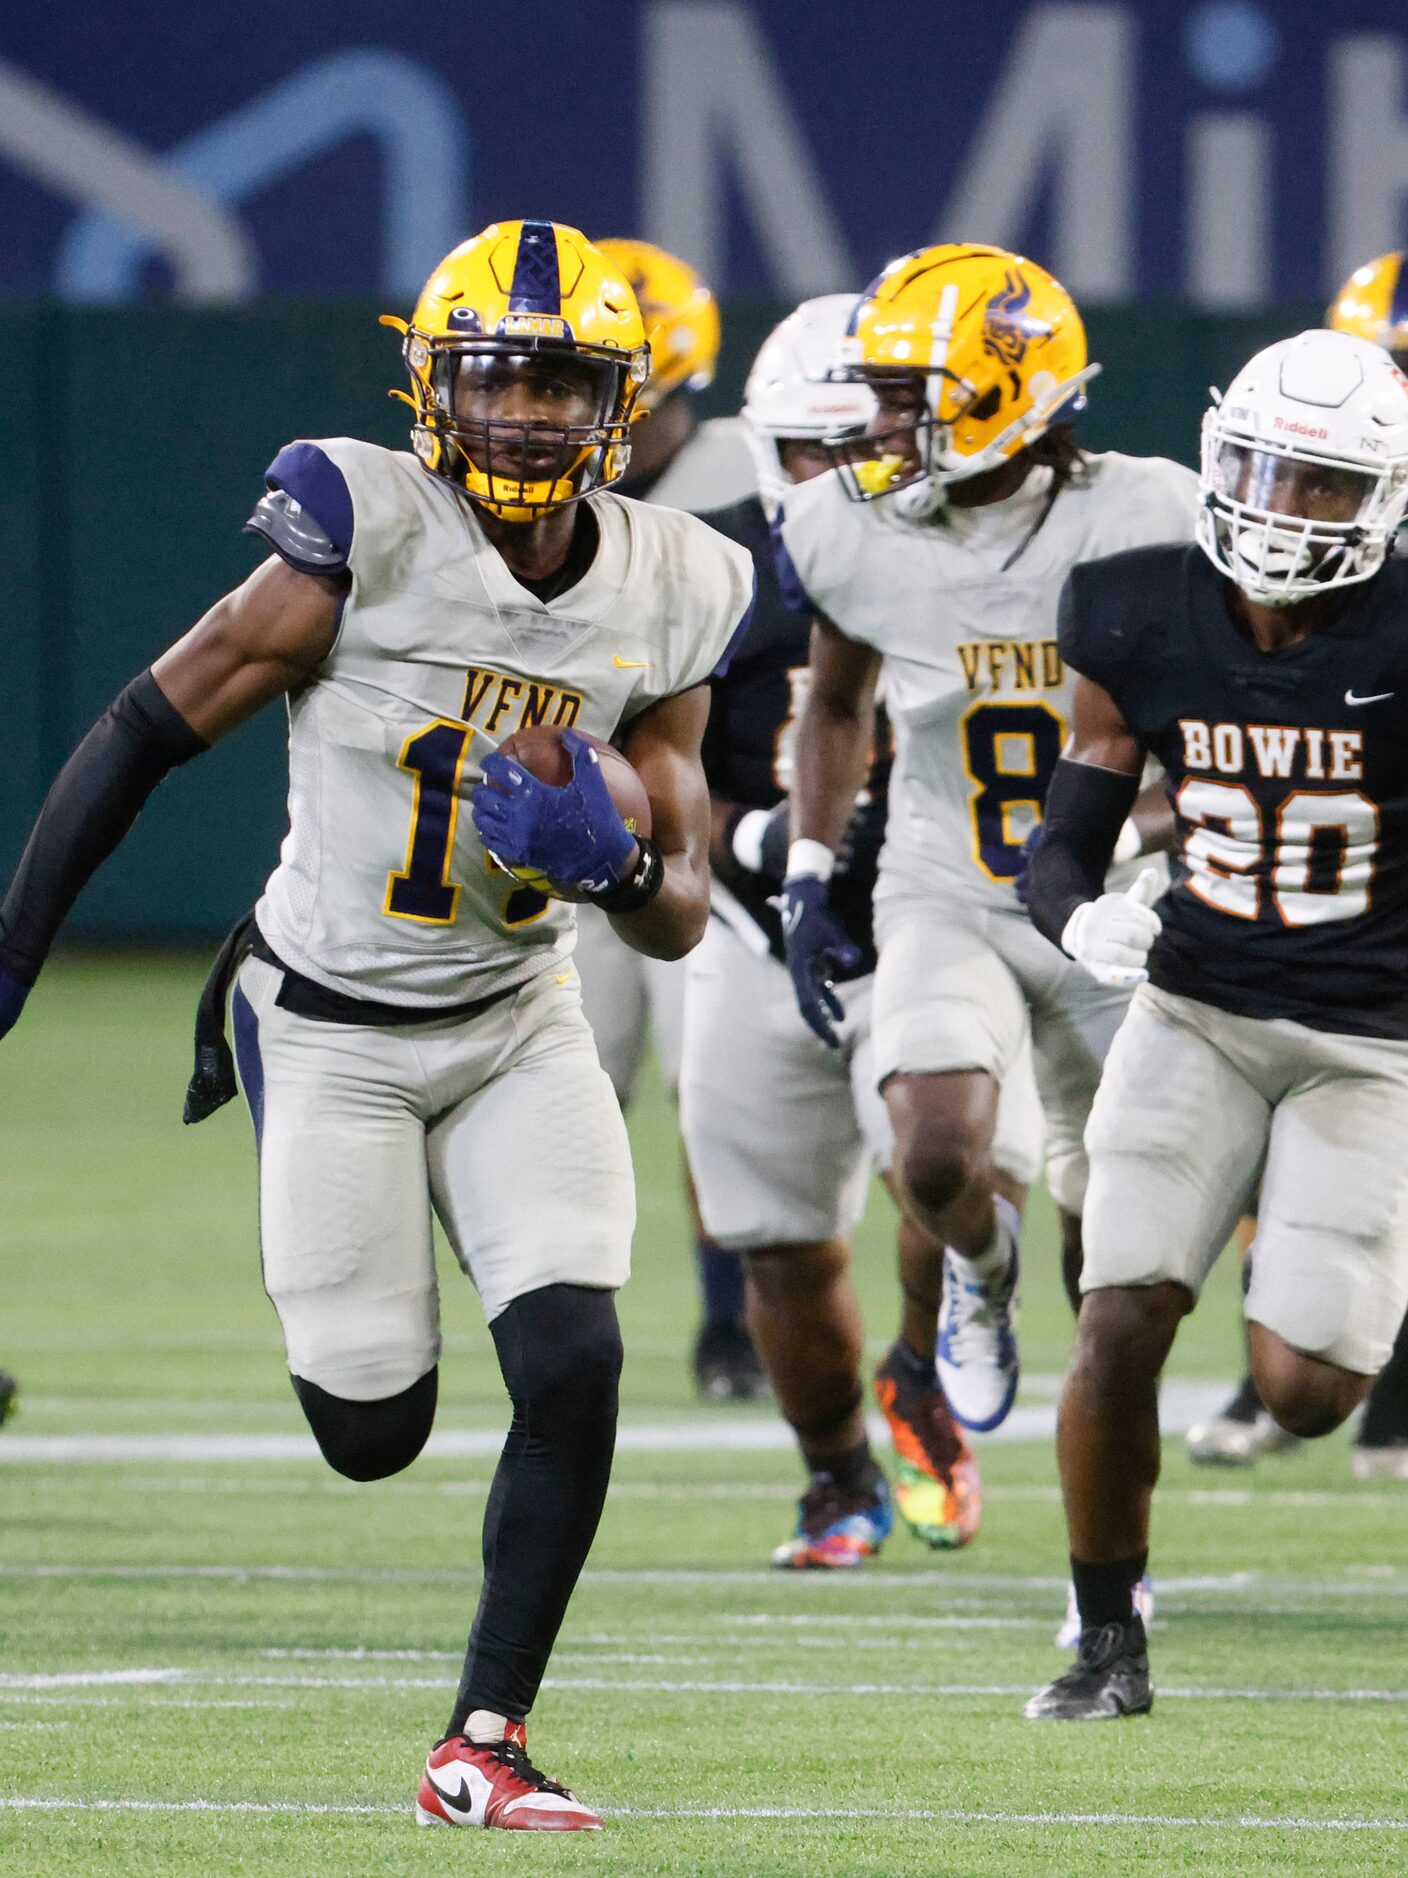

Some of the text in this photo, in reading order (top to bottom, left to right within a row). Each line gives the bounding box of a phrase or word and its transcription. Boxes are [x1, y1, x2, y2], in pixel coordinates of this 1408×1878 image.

[505, 316, 565, 338] LAMAR
[1273, 416, 1329, 441] Riddell
[956, 639, 1064, 693] VFND
[460, 667, 585, 734] VFND
[1177, 718, 1364, 781] BOWIE
[960, 699, 1071, 884] 8
[1175, 774, 1382, 928] 20
